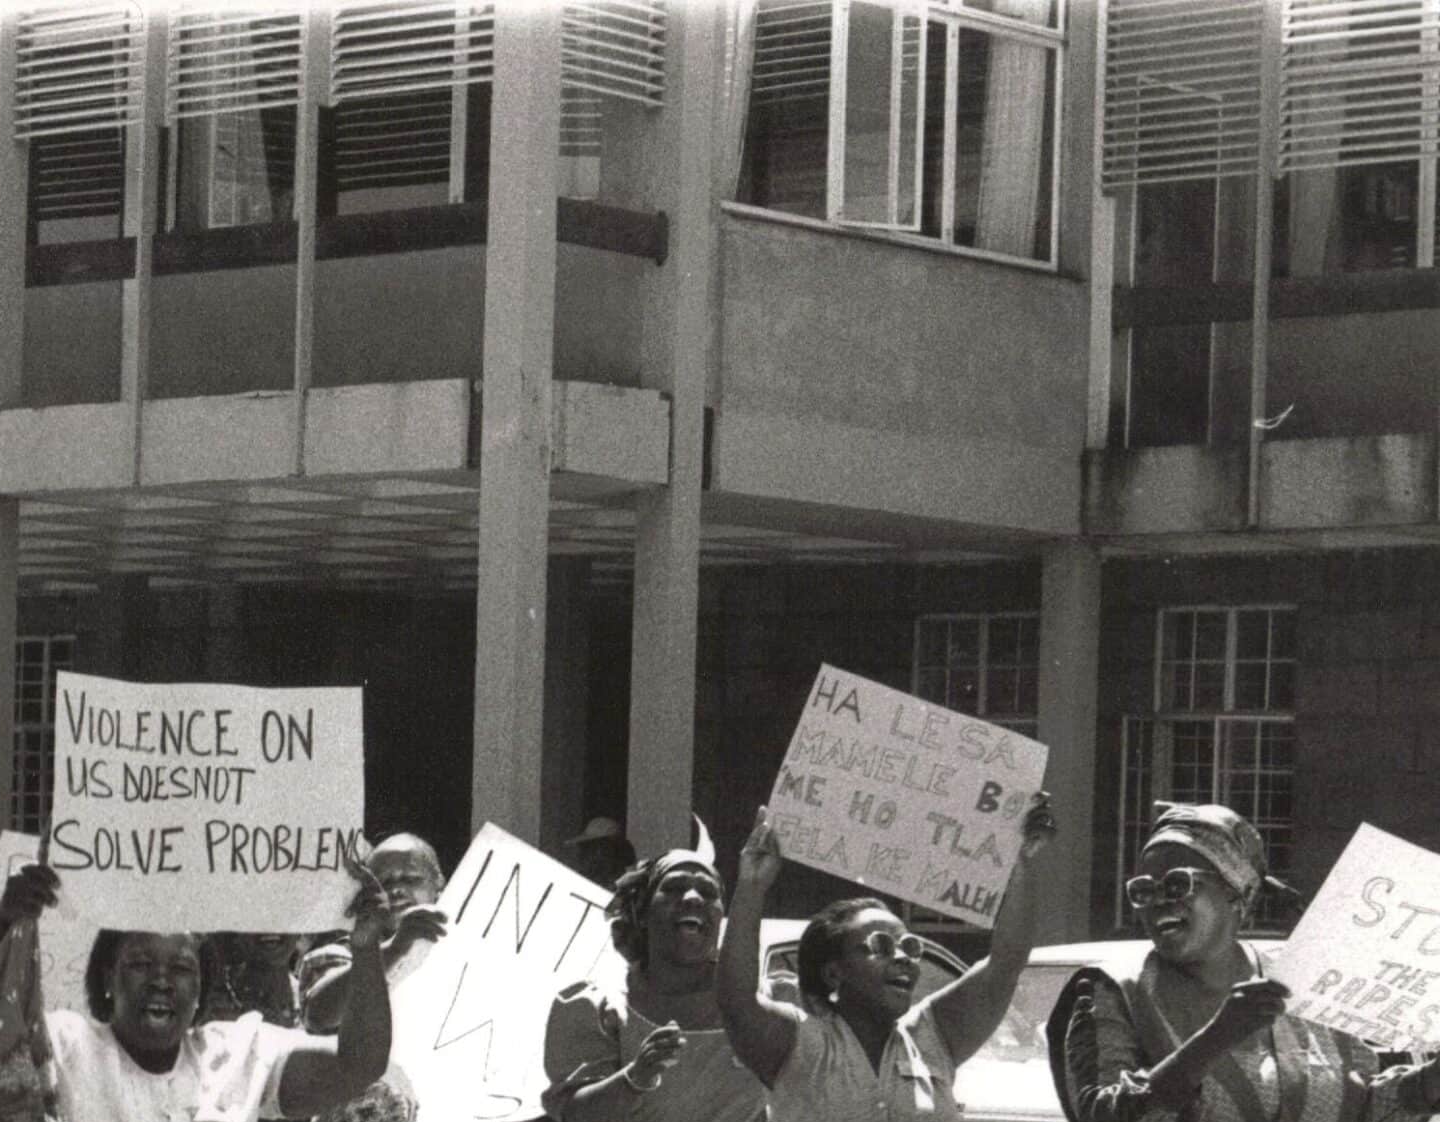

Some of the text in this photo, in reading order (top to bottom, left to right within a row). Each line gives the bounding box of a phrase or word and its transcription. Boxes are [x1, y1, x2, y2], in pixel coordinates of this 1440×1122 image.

[63, 689, 314, 764] VIOLENCE ON
[811, 676, 861, 723] HA
[66, 756, 113, 800] US
[789, 725, 959, 798] MAMELE
[51, 818, 185, 876] SOLVE
[847, 790, 898, 830] HO
[925, 811, 1003, 868] TLA
